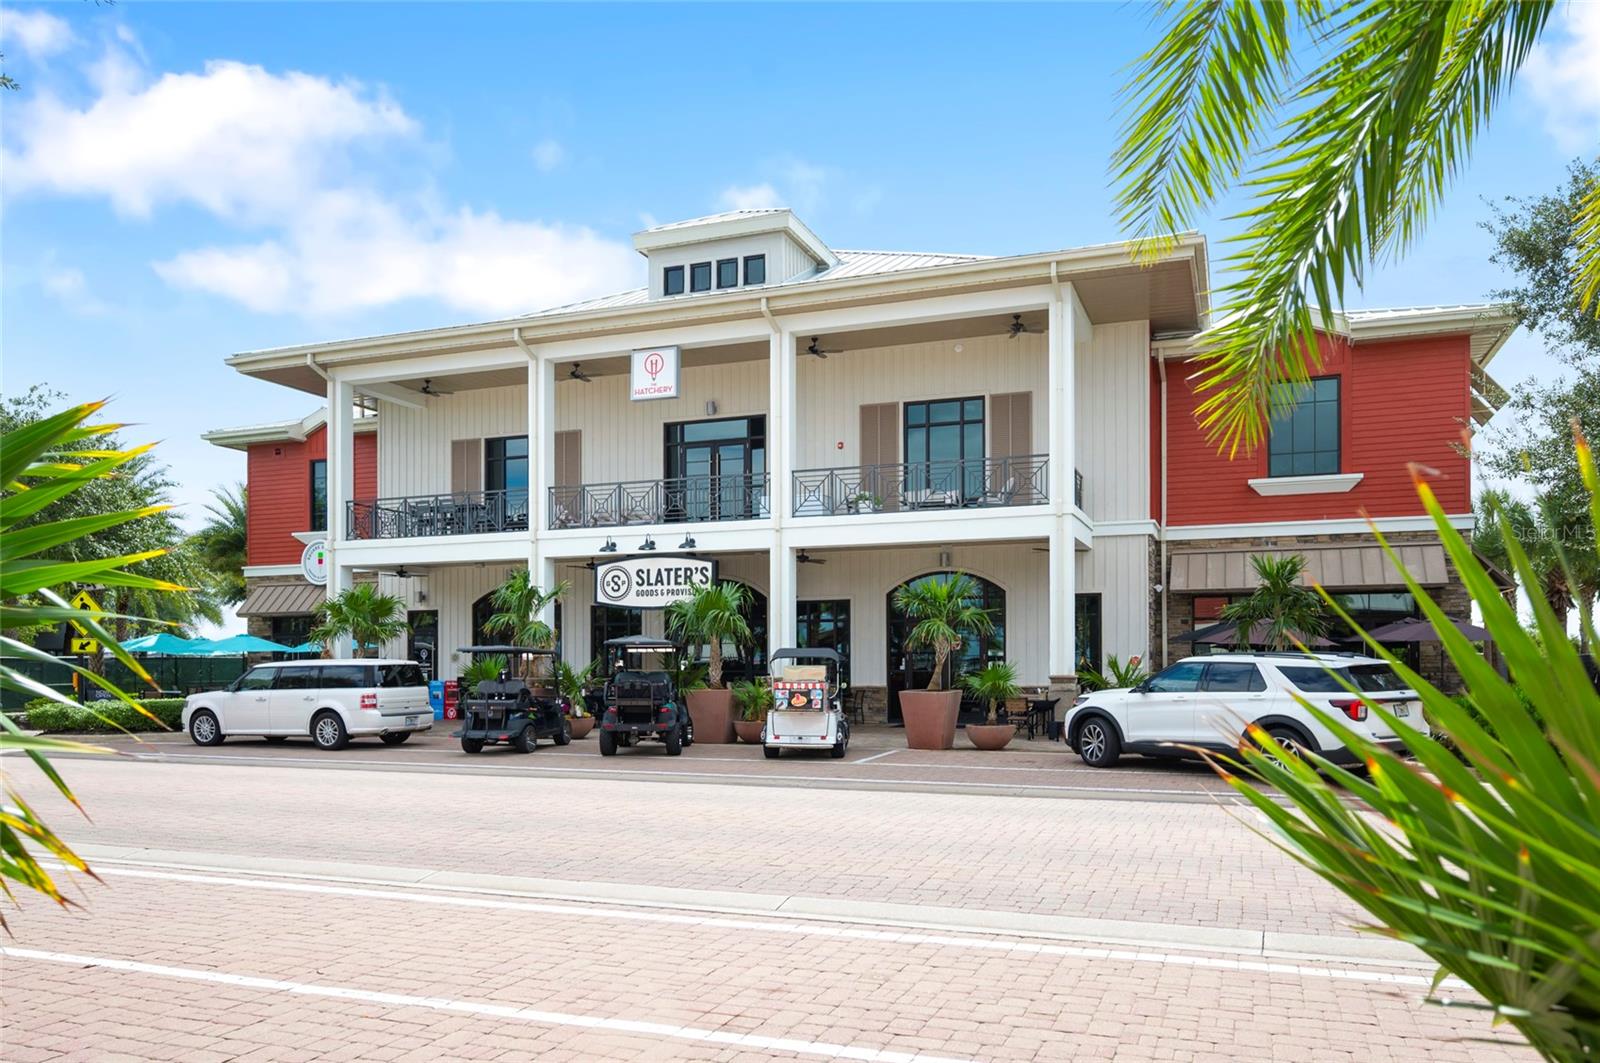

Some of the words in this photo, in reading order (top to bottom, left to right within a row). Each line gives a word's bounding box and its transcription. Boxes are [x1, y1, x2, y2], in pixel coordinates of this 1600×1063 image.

[634, 386, 672, 396] HATCHERY
[635, 566, 709, 587] SLATER'S
[636, 589, 659, 598] GOODS
[660, 589, 665, 597] &
